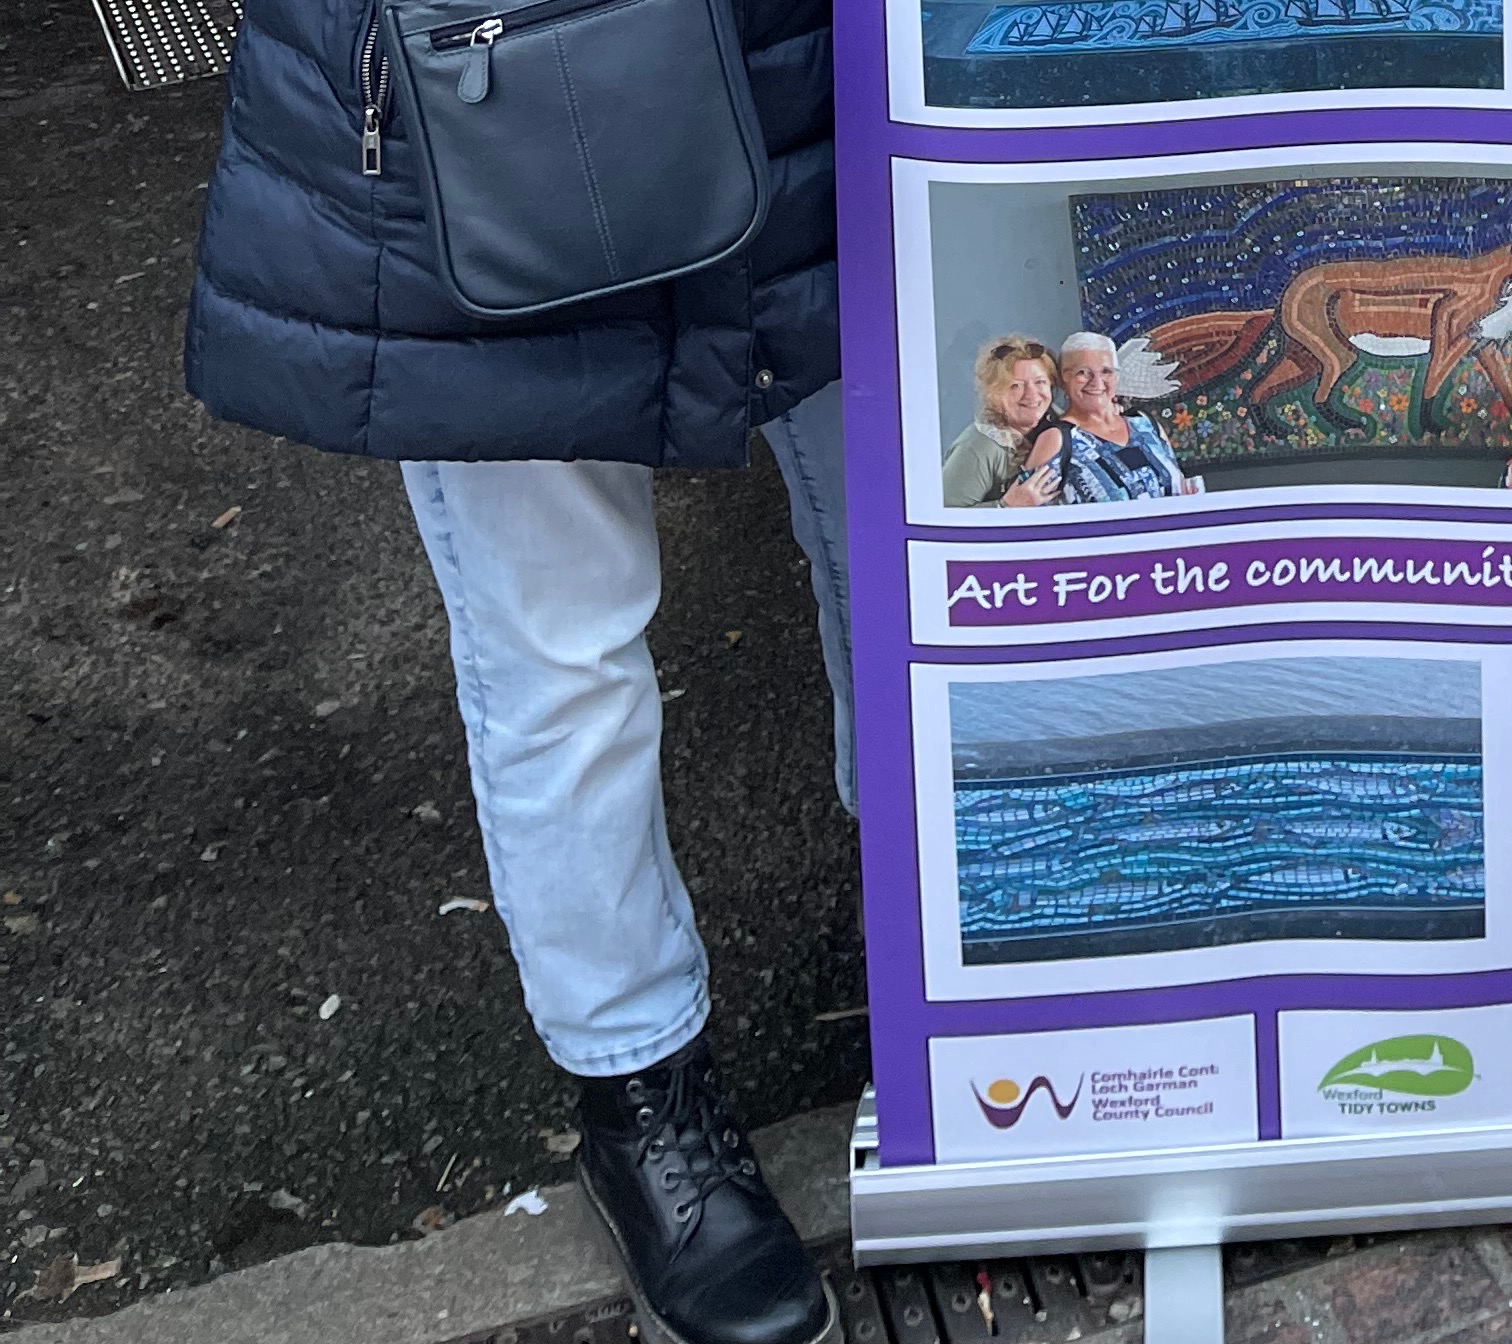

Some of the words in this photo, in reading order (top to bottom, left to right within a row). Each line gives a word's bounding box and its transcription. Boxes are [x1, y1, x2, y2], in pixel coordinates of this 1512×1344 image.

[947, 570, 1038, 610] Art
[1052, 568, 1141, 607] For
[1150, 557, 1231, 595] the
[1091, 1067, 1174, 1083] Comhairle
[1178, 1064, 1219, 1078] Cont
[1091, 1081, 1128, 1095] Loch
[1133, 1079, 1198, 1092] Garman
[1322, 1088, 1384, 1101] Wexford
[1091, 1094, 1161, 1110] Wexford
[1338, 1102, 1374, 1114] TIDY
[1377, 1099, 1437, 1115] TOWNS
[1092, 1110, 1150, 1122] County
[1154, 1101, 1214, 1118] Council
